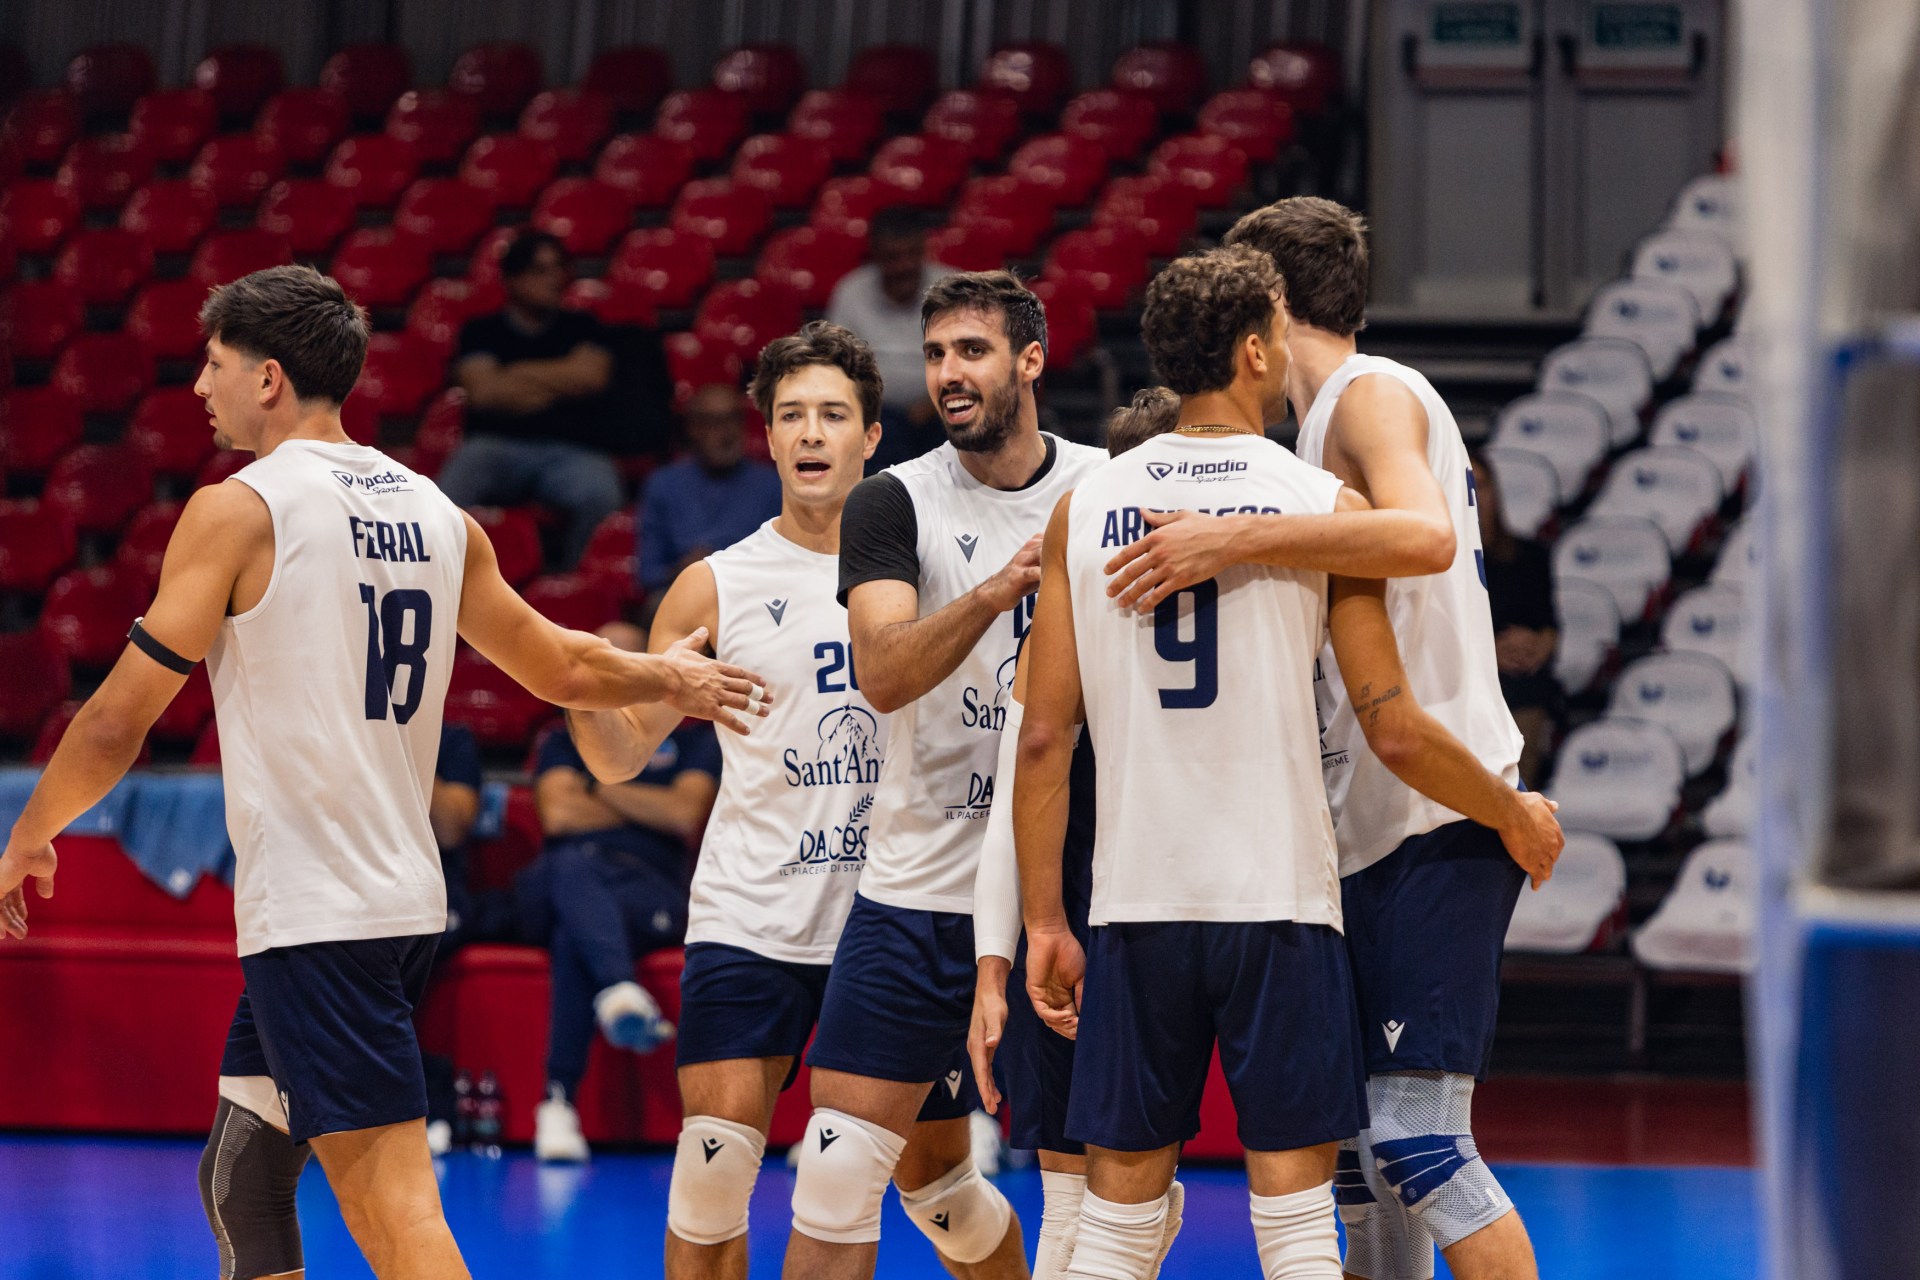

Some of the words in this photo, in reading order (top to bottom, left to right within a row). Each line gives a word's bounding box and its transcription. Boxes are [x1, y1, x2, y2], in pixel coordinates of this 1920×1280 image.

[365, 471, 408, 490] podio
[1177, 462, 1188, 474] il
[1191, 460, 1248, 477] podio
[349, 516, 431, 563] FERAL
[358, 582, 433, 725] 18
[1153, 577, 1219, 709] 9
[813, 640, 860, 694] 2
[783, 743, 885, 787] Sant'An
[945, 811, 955, 820] IL
[830, 864, 840, 873] DI
